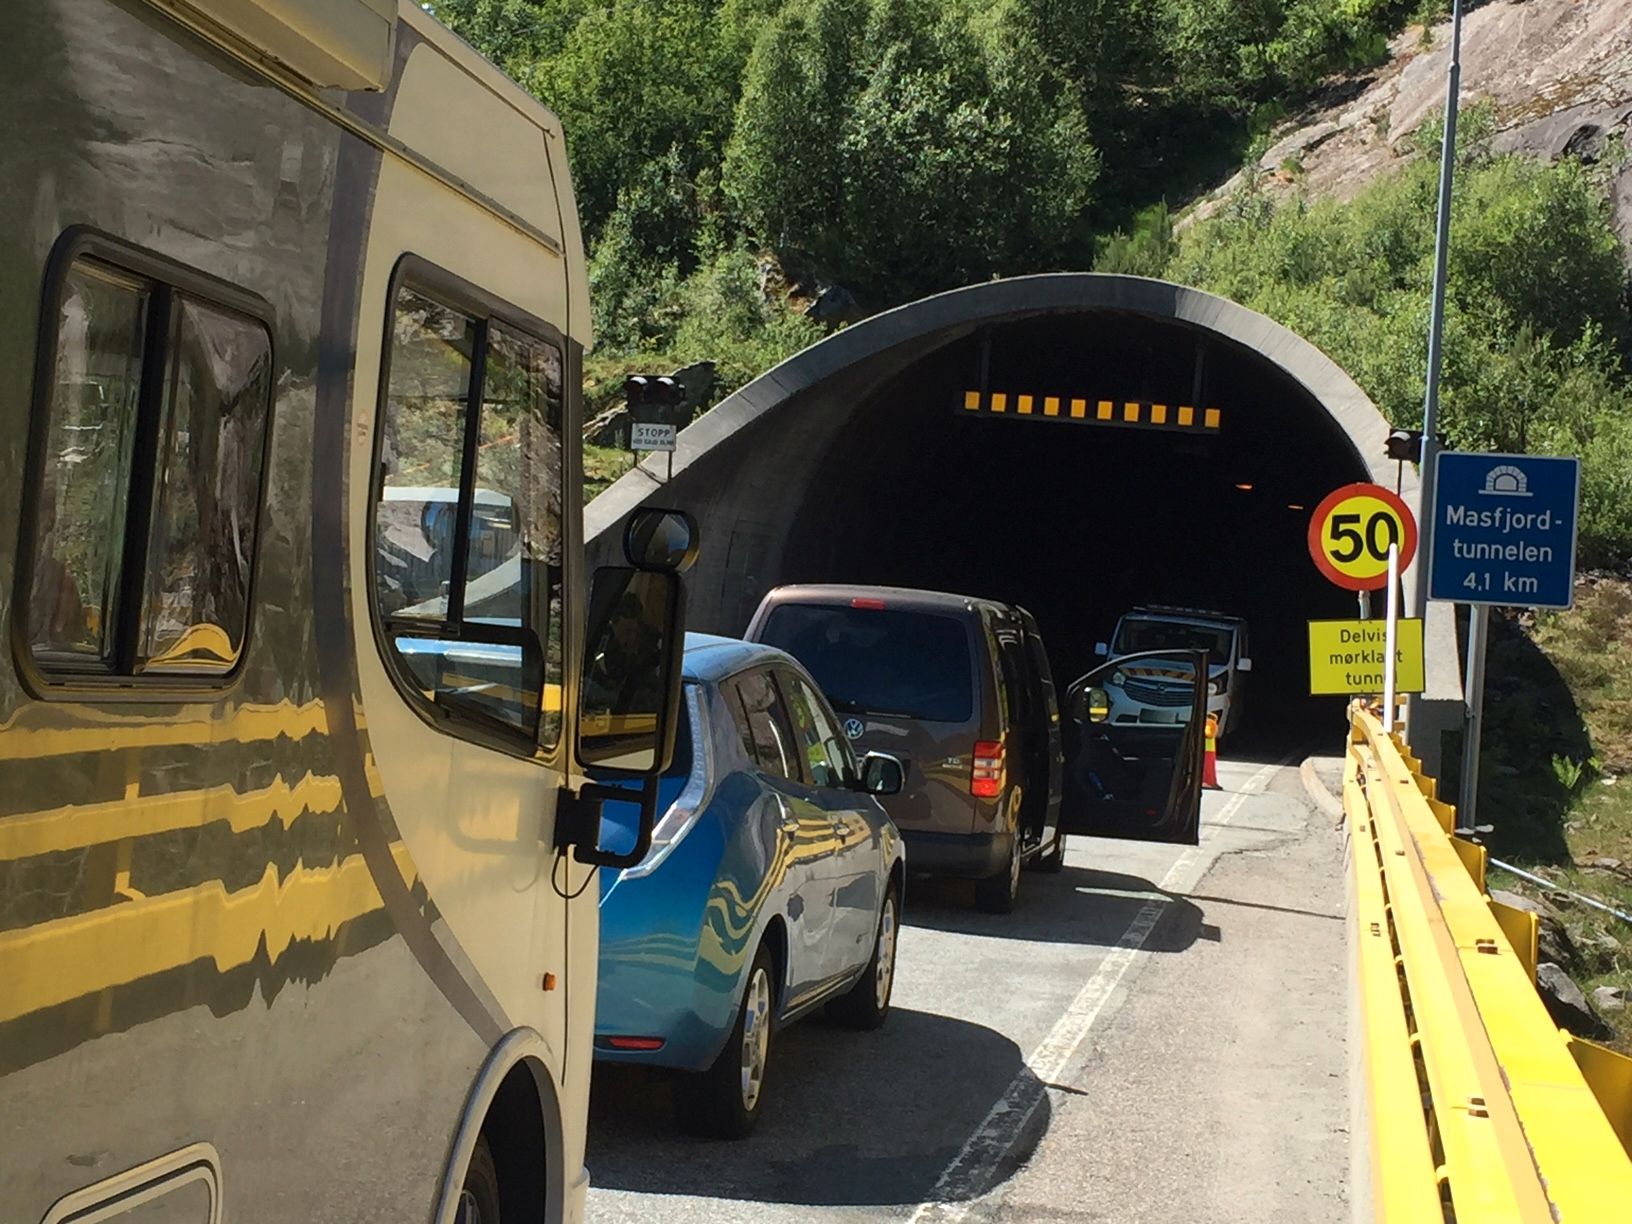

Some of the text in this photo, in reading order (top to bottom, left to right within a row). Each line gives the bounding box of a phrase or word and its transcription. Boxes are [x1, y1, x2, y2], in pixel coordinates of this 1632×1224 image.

[638, 428, 670, 437] STOPP
[1446, 505, 1563, 533] Masfjord-
[1330, 511, 1398, 563] 50
[1453, 538, 1552, 562] tunnelen
[1463, 571, 1538, 593] 4,1 km
[1329, 649, 1403, 665] mørklat
